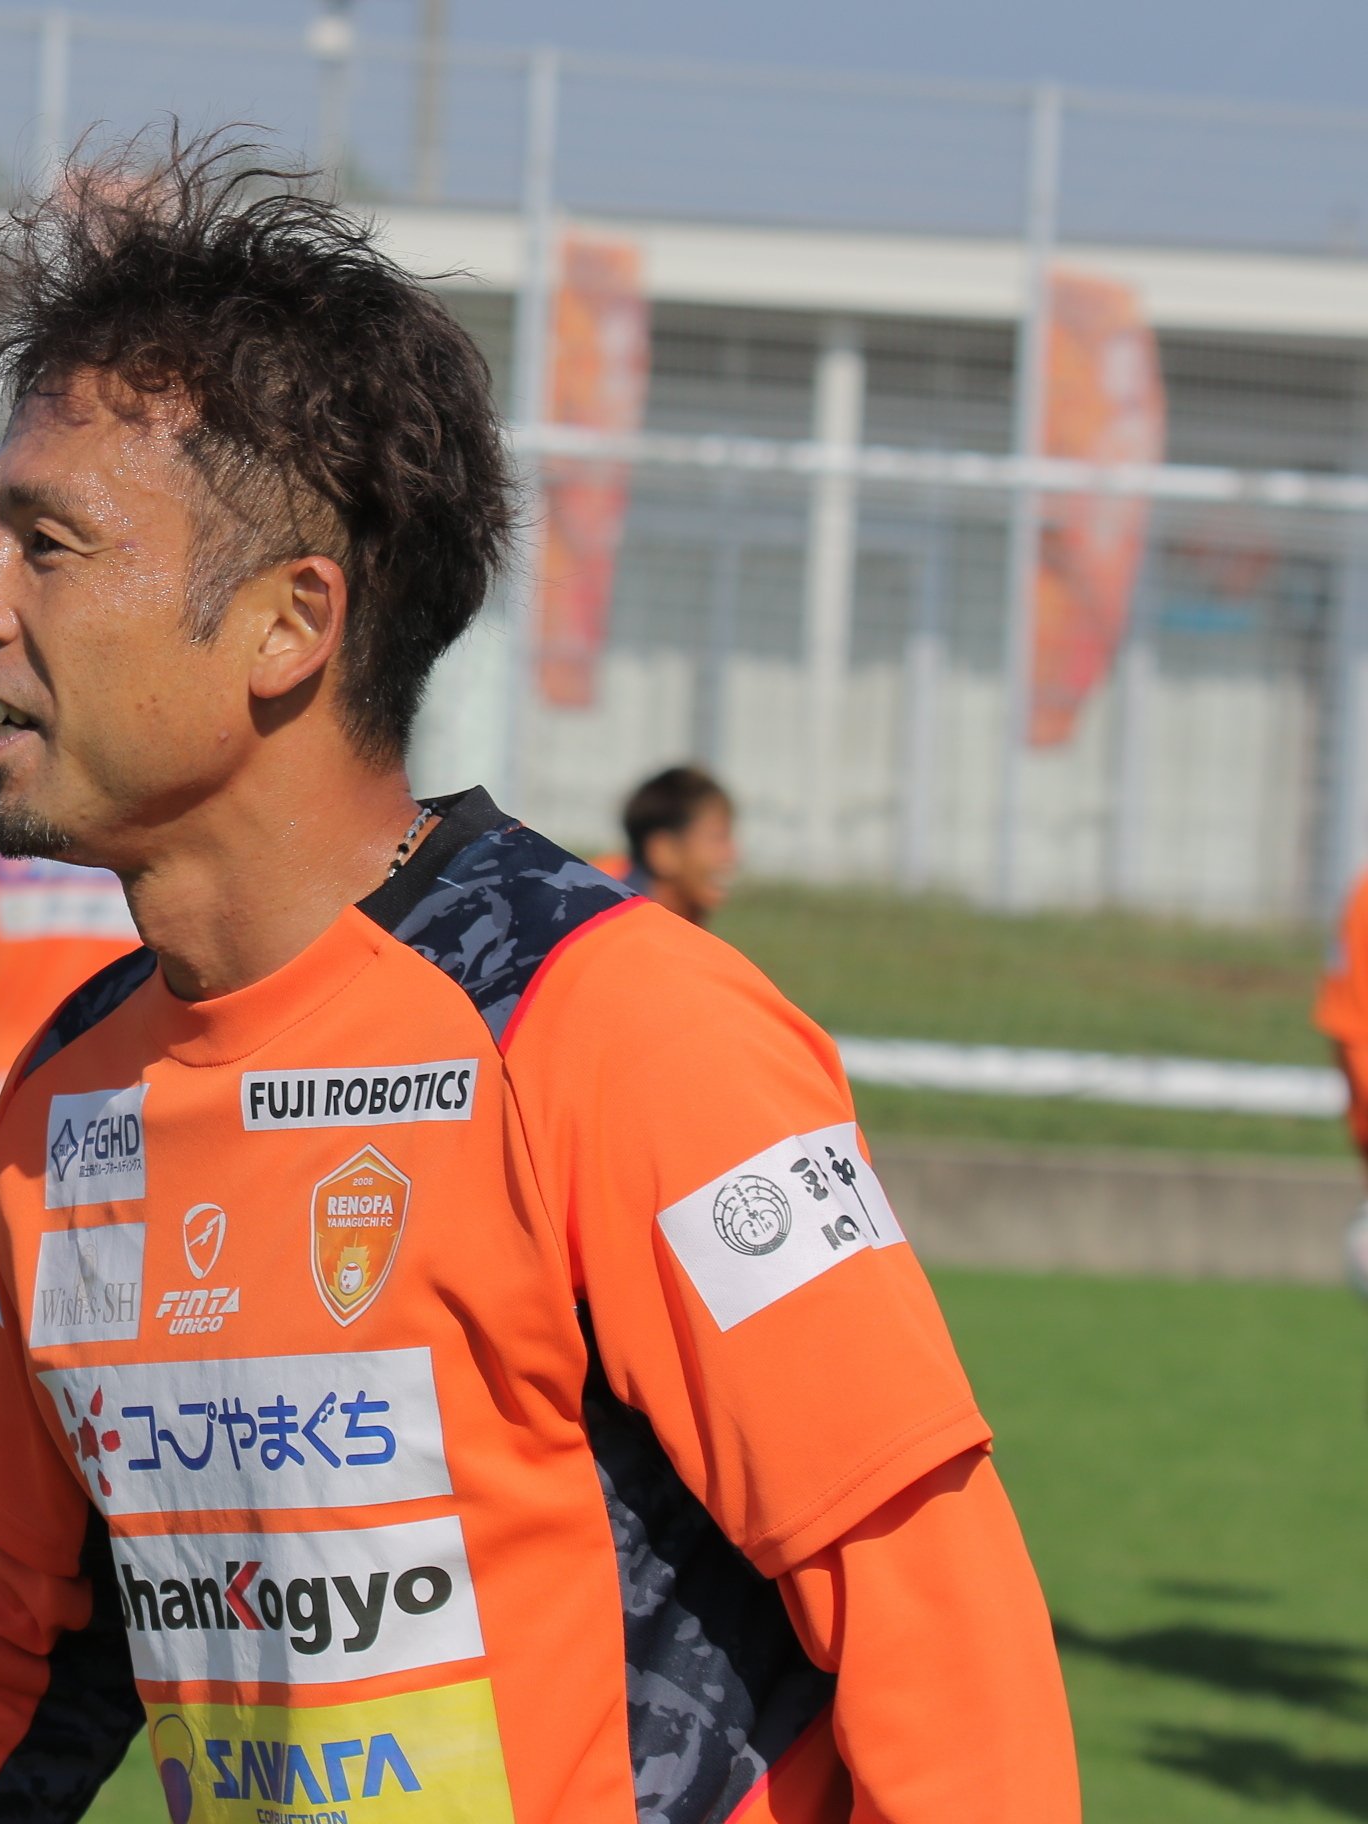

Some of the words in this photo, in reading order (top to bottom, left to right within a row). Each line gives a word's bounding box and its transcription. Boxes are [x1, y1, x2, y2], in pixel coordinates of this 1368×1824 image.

[250, 1079, 316, 1120] FUJI
[324, 1070, 471, 1117] ROBOTICS
[80, 1113, 141, 1162] FGHD
[327, 1195, 394, 1216] RENOFA
[327, 1216, 379, 1228] YAMAGUCHI
[380, 1216, 393, 1227] FC
[155, 1287, 241, 1319] FINTA
[167, 1315, 224, 1335] UNICO
[121, 1390, 397, 1472] コープやまぐち
